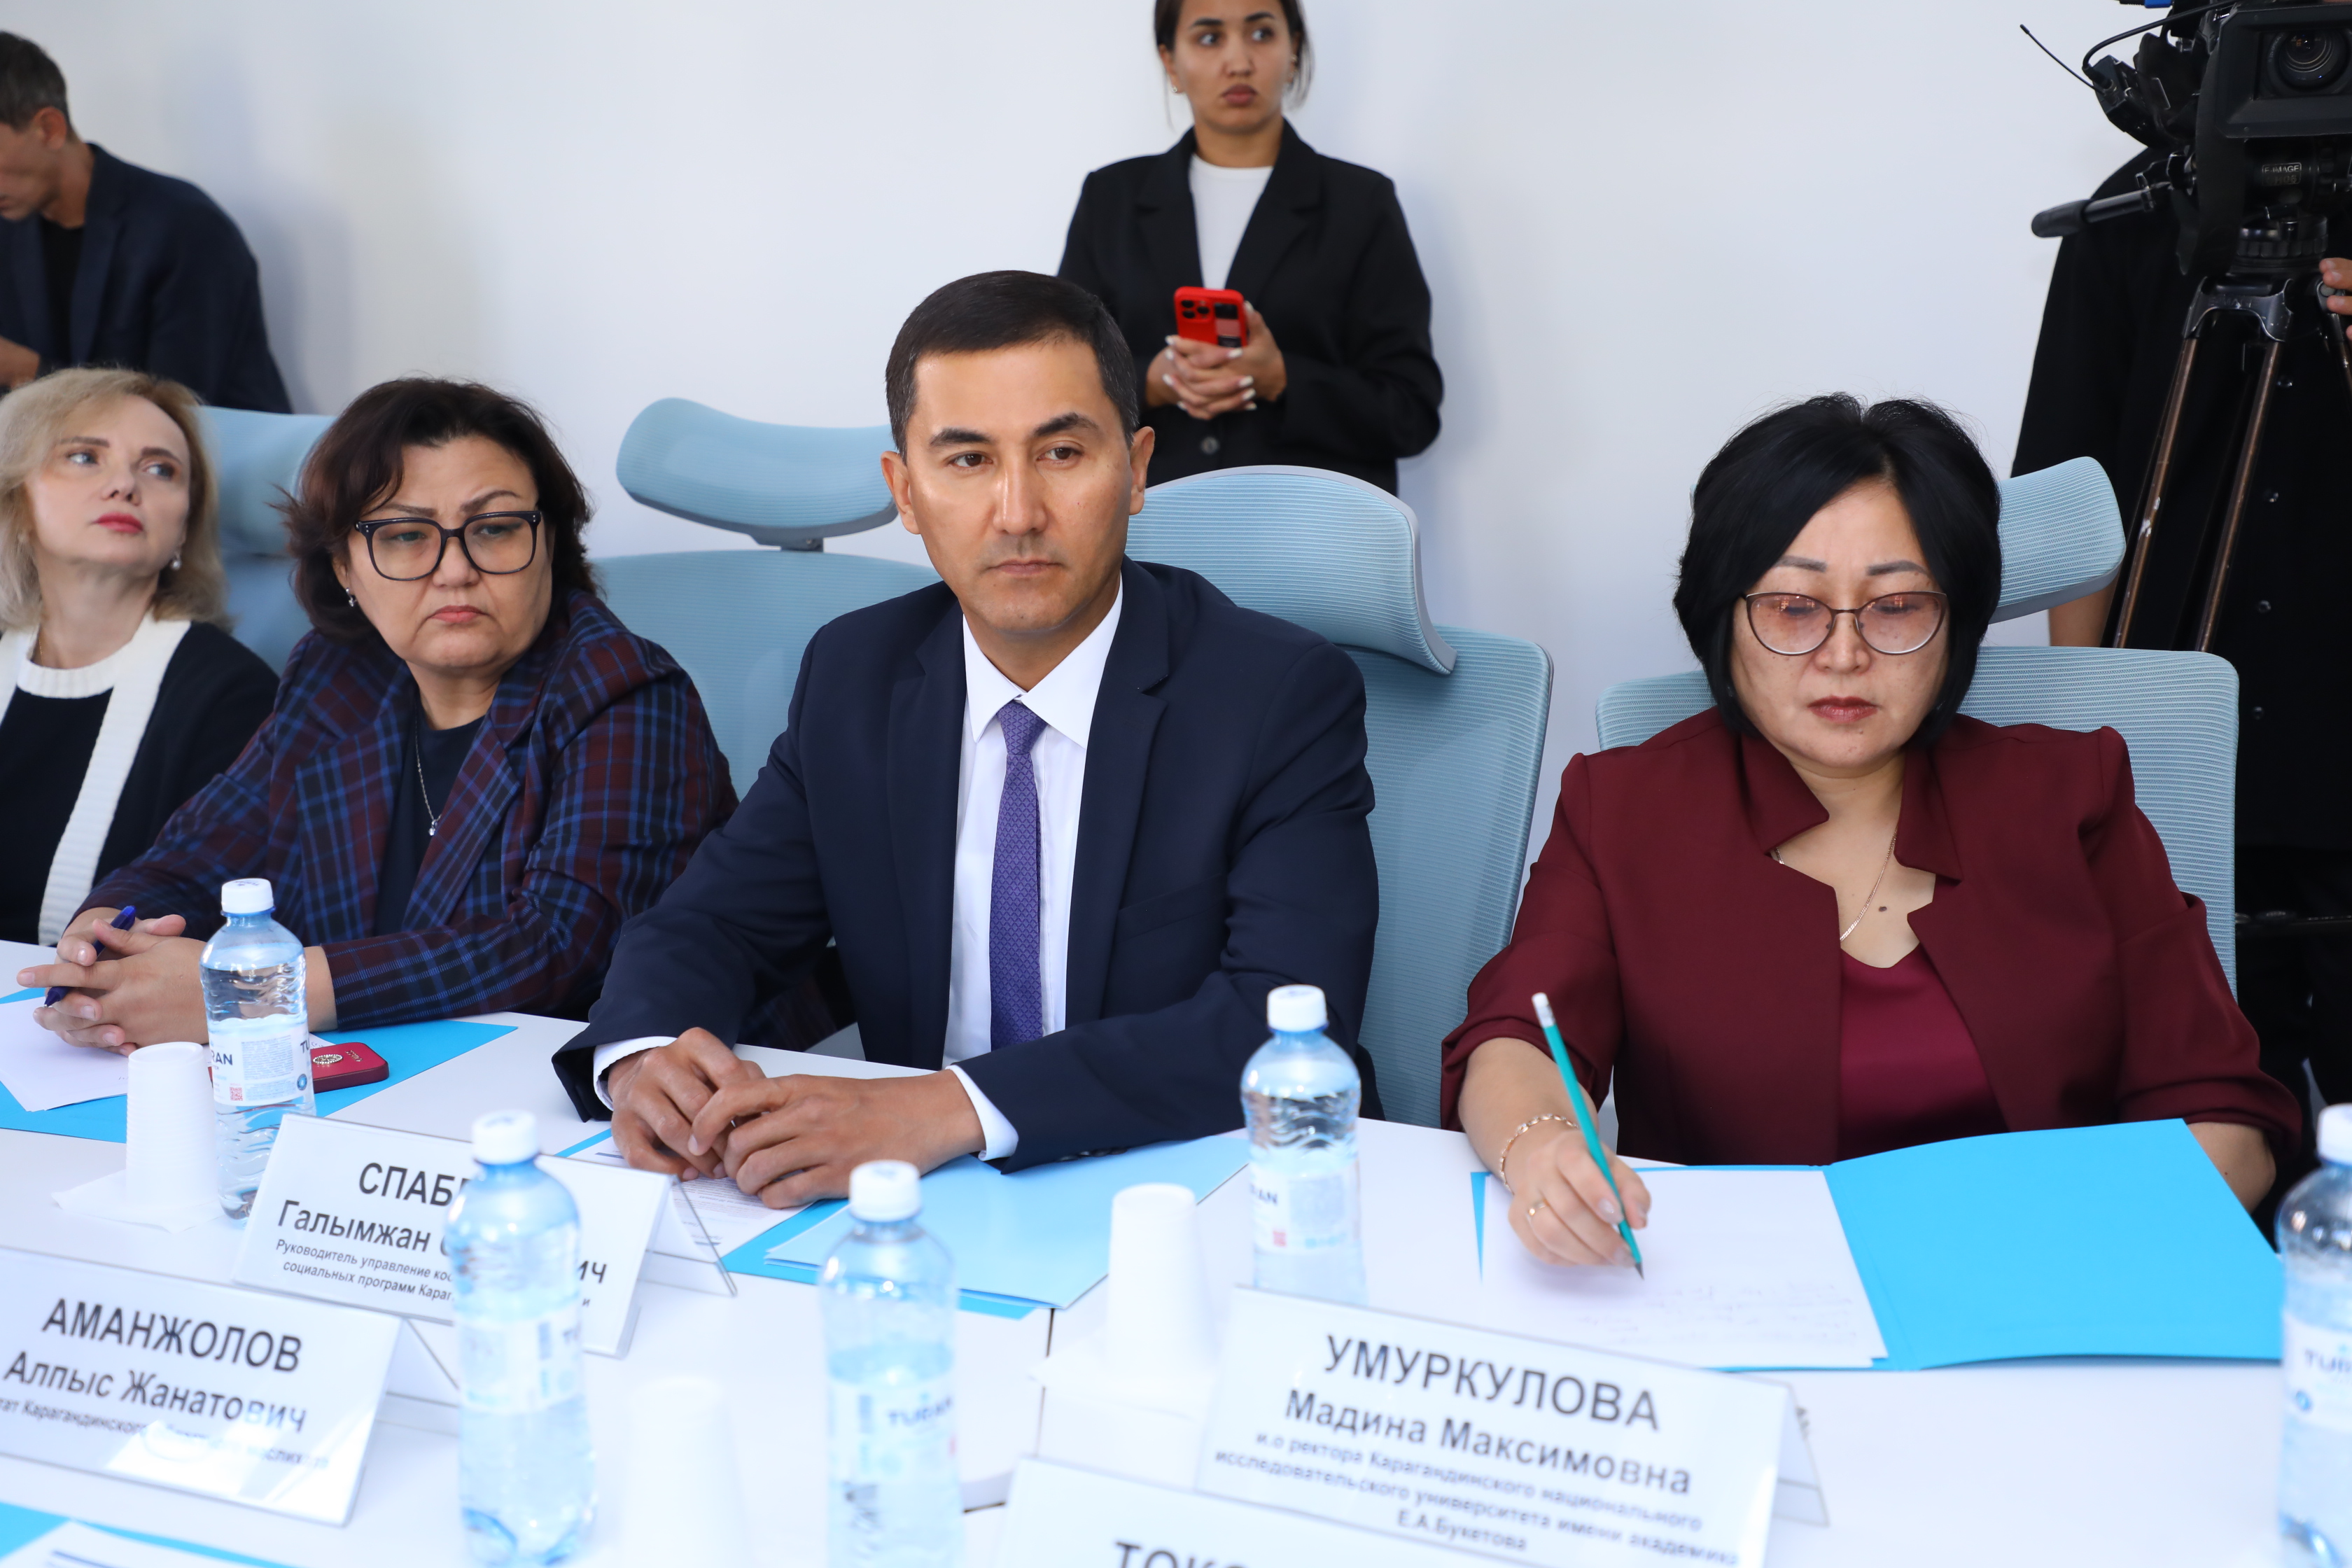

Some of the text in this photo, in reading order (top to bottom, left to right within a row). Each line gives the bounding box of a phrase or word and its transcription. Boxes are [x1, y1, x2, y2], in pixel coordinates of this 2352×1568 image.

[358, 1161, 471, 1207] СПАБ
[276, 1238, 358, 1265] Руководитель
[359, 1257, 431, 1279] управление
[277, 1199, 432, 1252] Галымжан
[283, 1261, 356, 1284] социальных
[357, 1274, 416, 1295] программ
[41, 1298, 303, 1373] АМАНЖОЛОВ
[3, 1350, 307, 1433] Алпыс Жанатович
[1324, 1334, 1659, 1431] УМУРКУЛОВА
[1284, 1388, 1691, 1495] Мадина Максимовна
[1289, 1437, 1363, 1464] ректора
[1369, 1451, 1536, 1497] Карагандинского
[1214, 1450, 1410, 1500] исследовательского
[1415, 1490, 1550, 1529] университета
